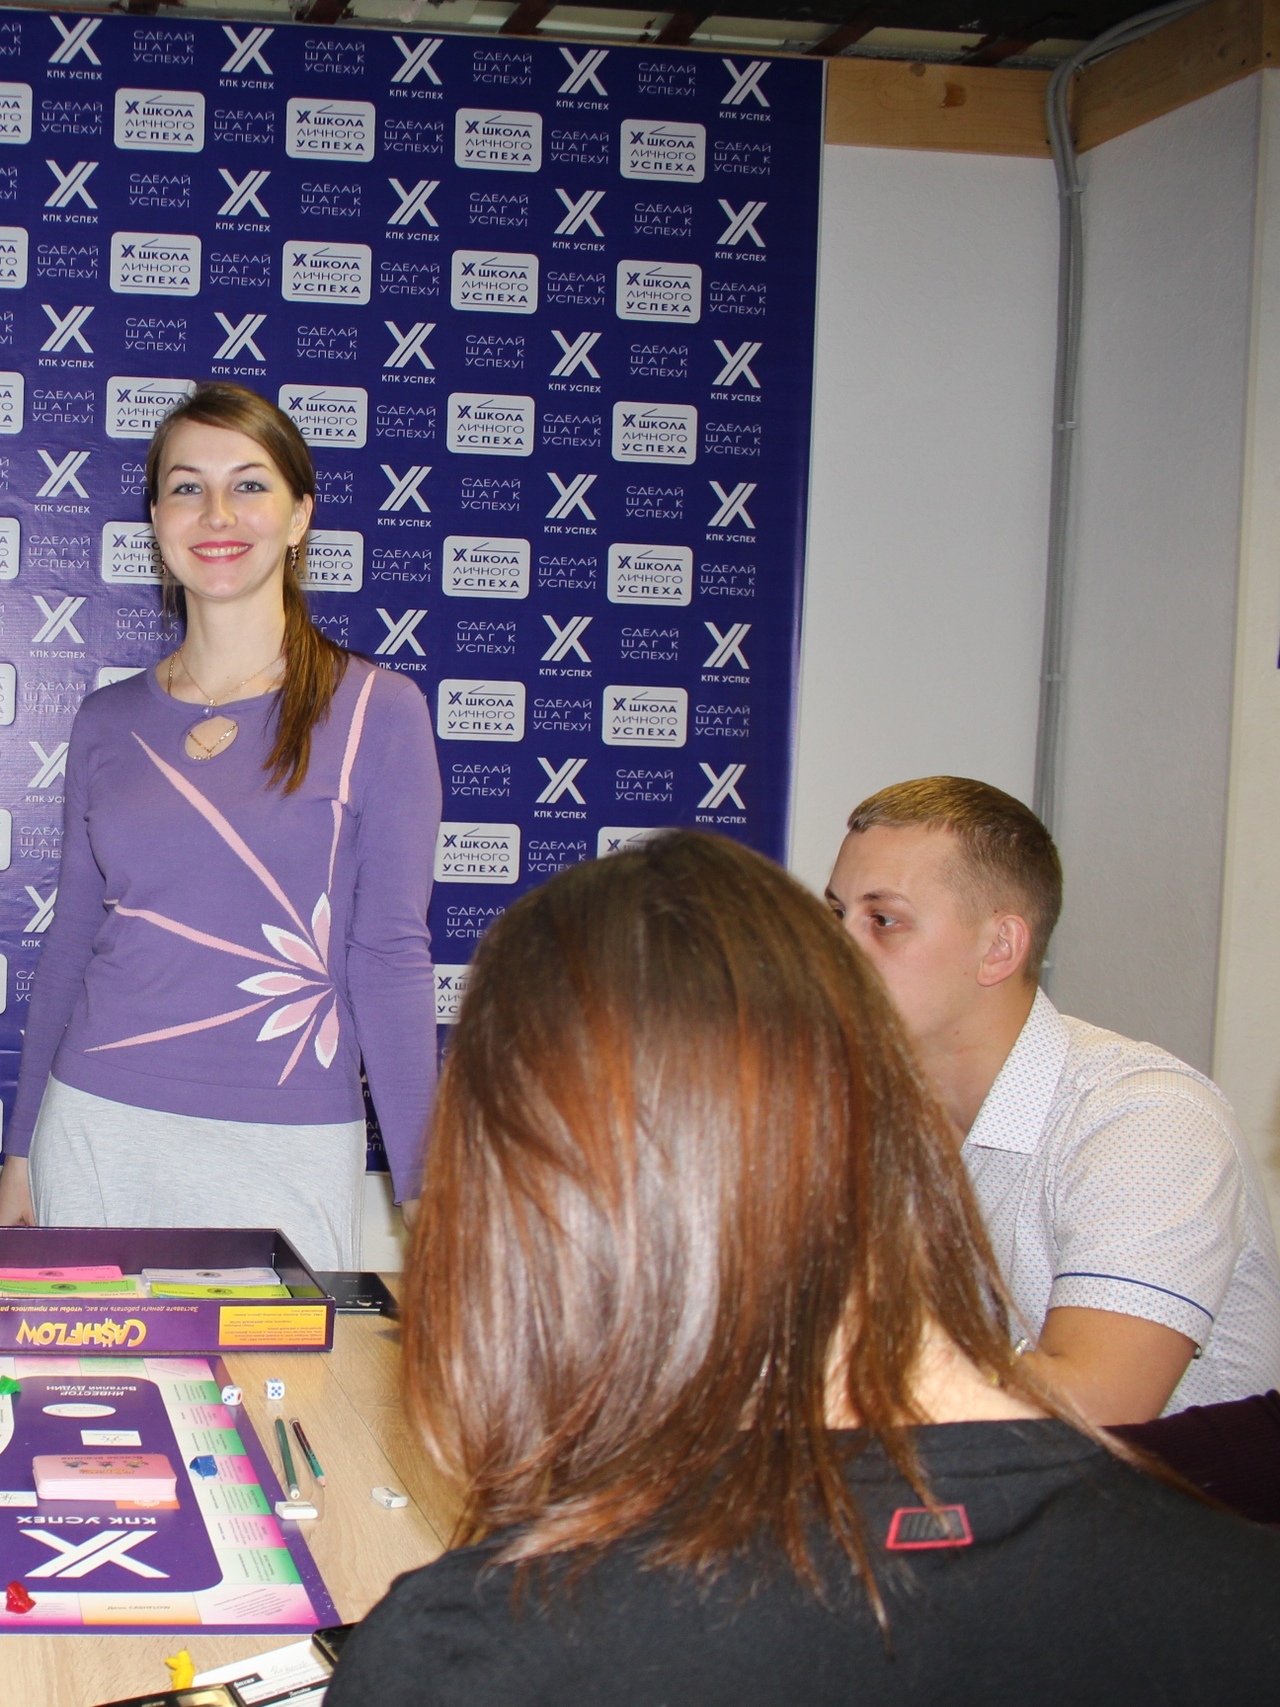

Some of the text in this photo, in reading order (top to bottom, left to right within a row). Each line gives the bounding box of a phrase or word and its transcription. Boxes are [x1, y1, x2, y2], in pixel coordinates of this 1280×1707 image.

[46, 69, 103, 81] КПК УСПЕХ
[389, 88, 444, 101] КПК УСПЕХ
[313, 116, 364, 128] ШКОЛА
[296, 128, 366, 139] ЛИЧНОГО
[296, 139, 365, 152] УСПЕХА
[646, 137, 695, 149] ШКОЛА
[630, 149, 696, 161] ЛИЧНОГО
[630, 160, 696, 173] УСПЕХА
[634, 202, 693, 215] СДЕЛАЙ
[634, 213, 672, 225] ШАГ
[215, 221, 271, 233] КПК УСПЕХ
[633, 225, 692, 238] УСПЕХУ!
[551, 240, 606, 252] КПК УСПЕХ
[309, 259, 360, 271] ШКОЛА
[293, 271, 362, 282] ЛИЧНОГО
[292, 282, 361, 294] УСПЕХА
[642, 278, 691, 290] ШКОЛА
[626, 290, 692, 302] ЛИЧНОГО
[626, 301, 692, 313] УСПЕХА
[547, 382, 602, 394] КПК УСПЕХ
[32, 389, 95, 401] СДЕЛАЙ
[32, 401, 73, 411] ШАГ
[32, 412, 94, 424] УСПЕХУ!
[638, 420, 687, 431] ШКОЛА
[622, 432, 688, 443] ЛИЧНОГО
[621, 442, 687, 455] УСПЕХА
[705, 532, 757, 544] КПК УСПЕХ
[470, 554, 519, 565] ШКОЛА
[453, 566, 520, 577] ЛИЧНОГО
[452, 577, 520, 588] УСПЕХА
[456, 620, 517, 632] СДЕЛАЙ
[456, 631, 496, 642] ШАГ
[29, 650, 86, 660] КПК УСПЕХ
[455, 643, 516, 655] УСПЕХУ!
[538, 667, 593, 678] КПК УСПЕХ
[465, 697, 514, 707] ШКОЛА
[448, 710, 515, 719] ЛИЧНОГО
[629, 703, 677, 714] ШКОЛА
[447, 720, 515, 731] УСПЕХА
[614, 715, 678, 725] ЛИЧНОГО
[612, 726, 677, 737] УСПЕХА
[615, 768, 674, 780] СДЕЛАЙ
[615, 780, 654, 790] ШАГ
[615, 791, 673, 803] УСПЕХУ!
[533, 809, 588, 820] КПК УСПЕХ
[10, 1305, 48, 1313] пришлось
[60, 1305, 83, 1313] чтобы
[110, 1305, 140, 1313] работать
[141, 1305, 166, 1313] деньги
[59, 1390, 125, 1398] ИНВЕСТОР
[16, 1515, 157, 1525] КПК УСПЕХ
